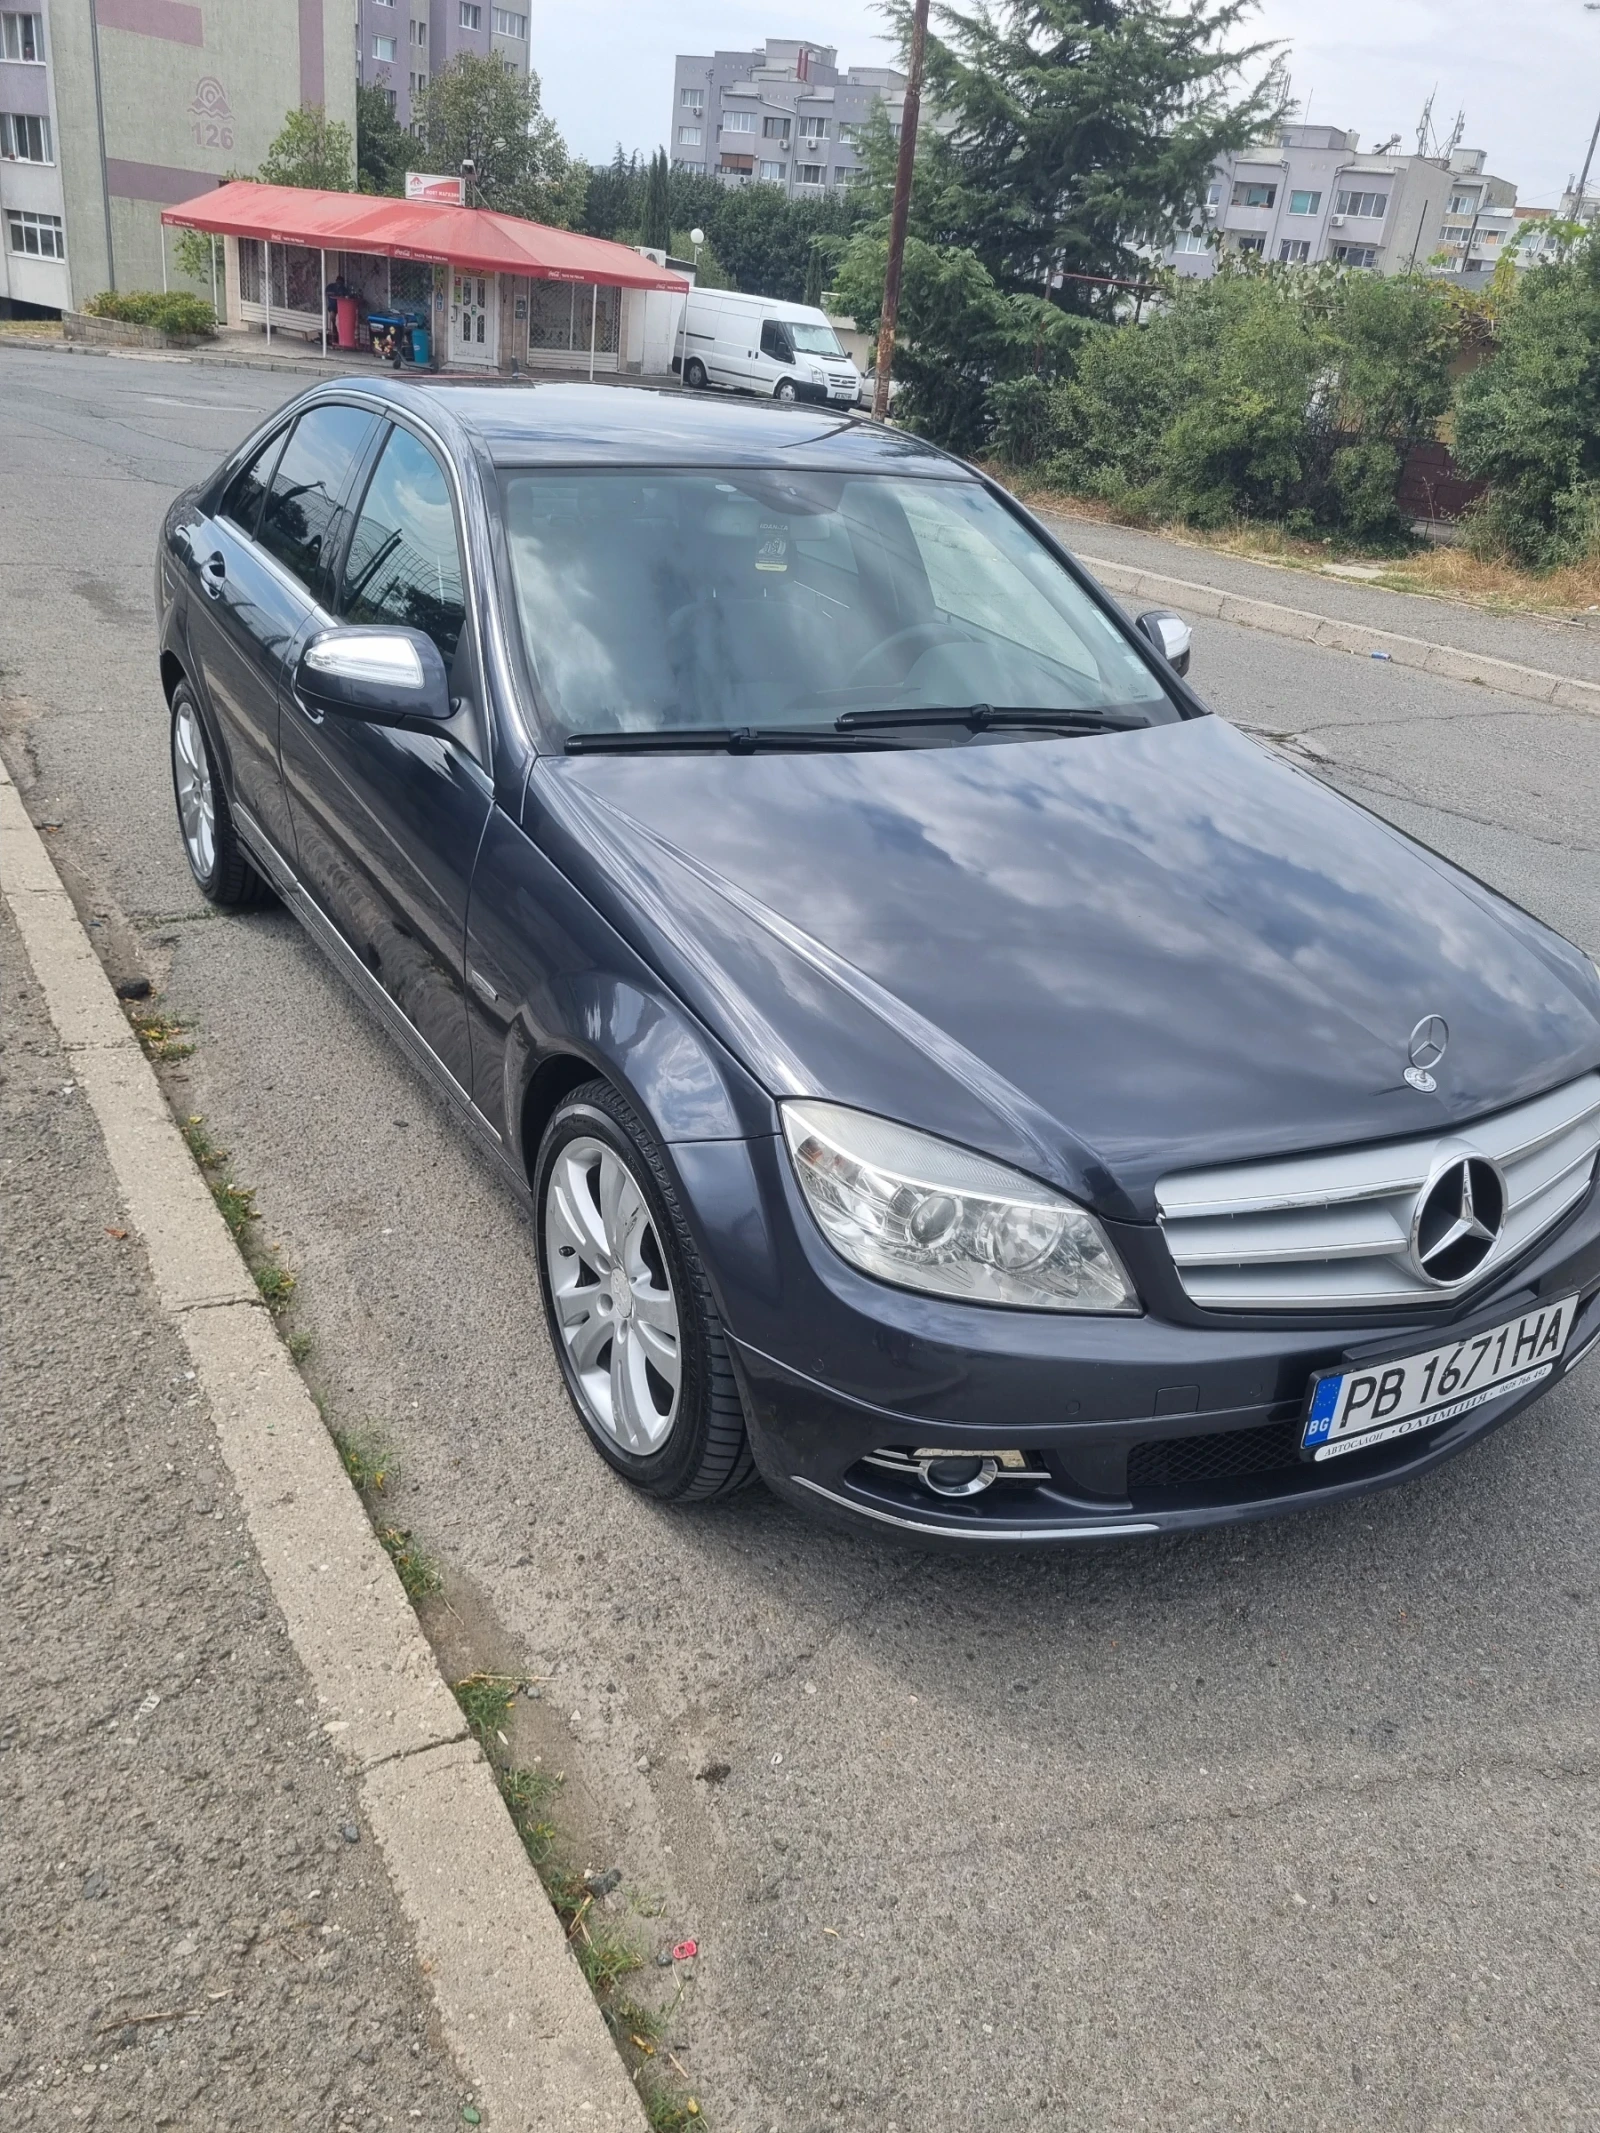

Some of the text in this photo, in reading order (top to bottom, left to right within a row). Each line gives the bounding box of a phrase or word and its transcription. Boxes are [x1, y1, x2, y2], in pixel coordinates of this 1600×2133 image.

[191, 122, 234, 150] 126
[1339, 1367, 1406, 1429] PB
[1308, 1417, 1330, 1435] BG
[1324, 1433, 1384, 1457] АВТОСАЛОН
[1398, 1393, 1488, 1433] ОЛИМПИЯ
